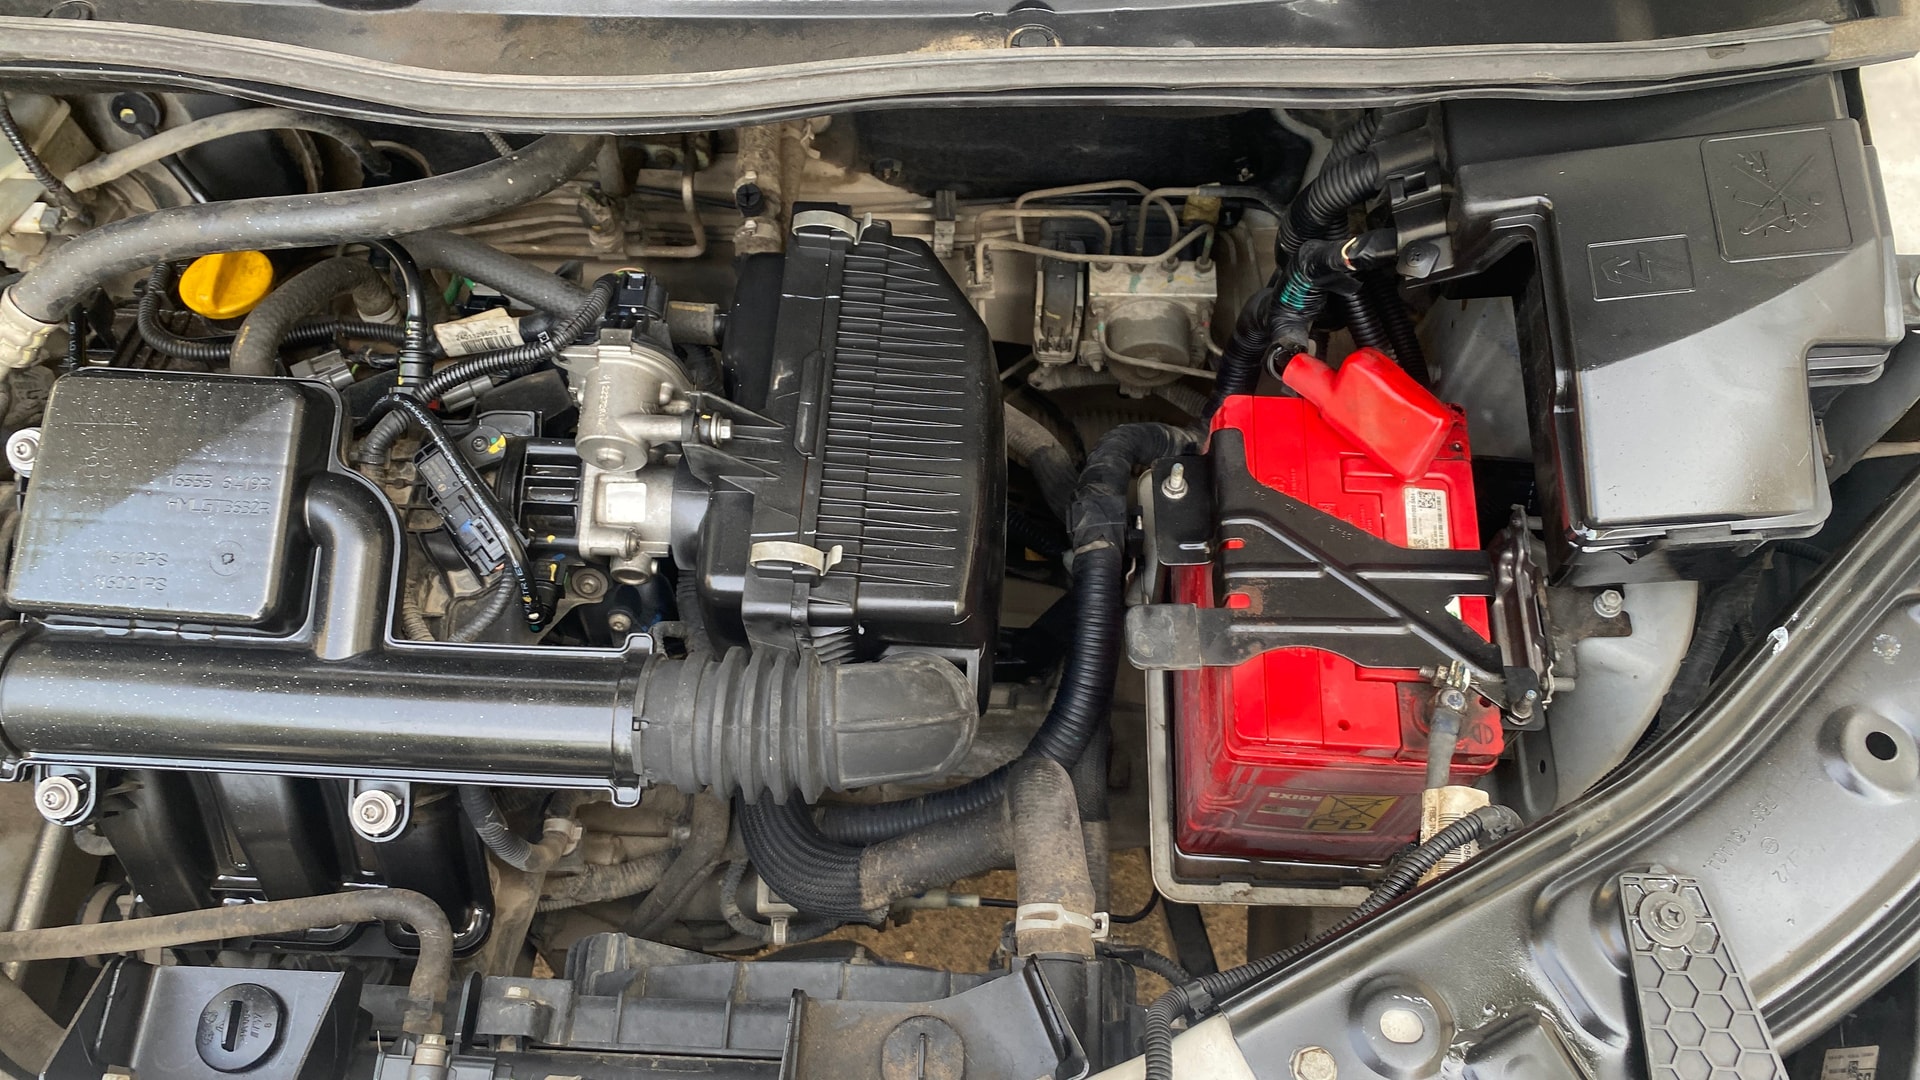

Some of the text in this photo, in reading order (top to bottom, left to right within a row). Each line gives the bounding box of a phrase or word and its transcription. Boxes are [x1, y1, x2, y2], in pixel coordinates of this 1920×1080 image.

[167, 473, 214, 488] 16555
[1268, 791, 1323, 802] EXIDE
[1307, 818, 1368, 830] Pb
